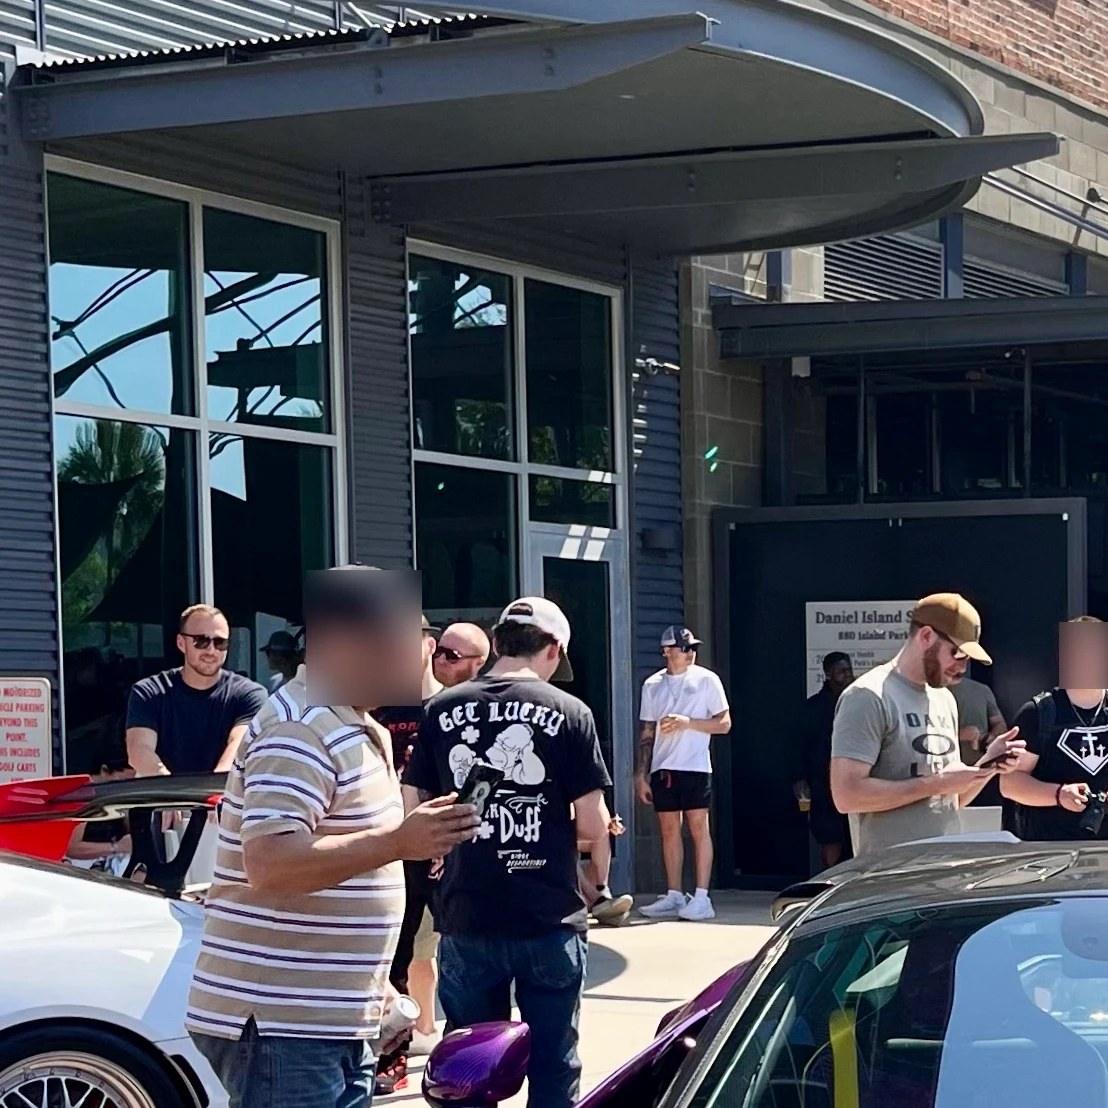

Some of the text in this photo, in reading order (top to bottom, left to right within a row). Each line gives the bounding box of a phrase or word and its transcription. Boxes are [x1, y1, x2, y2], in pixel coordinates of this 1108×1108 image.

[815, 611, 858, 624] Daniel
[861, 611, 902, 624] Island
[858, 629, 886, 641] Island
[3, 688, 42, 698] MOTORIZED
[15, 703, 45, 713] PARKING
[23, 718, 38, 728] THIS
[438, 701, 565, 737] GET LUCKY
[9, 748, 41, 758] INCLUDES
[16, 762, 37, 773] CARTS
